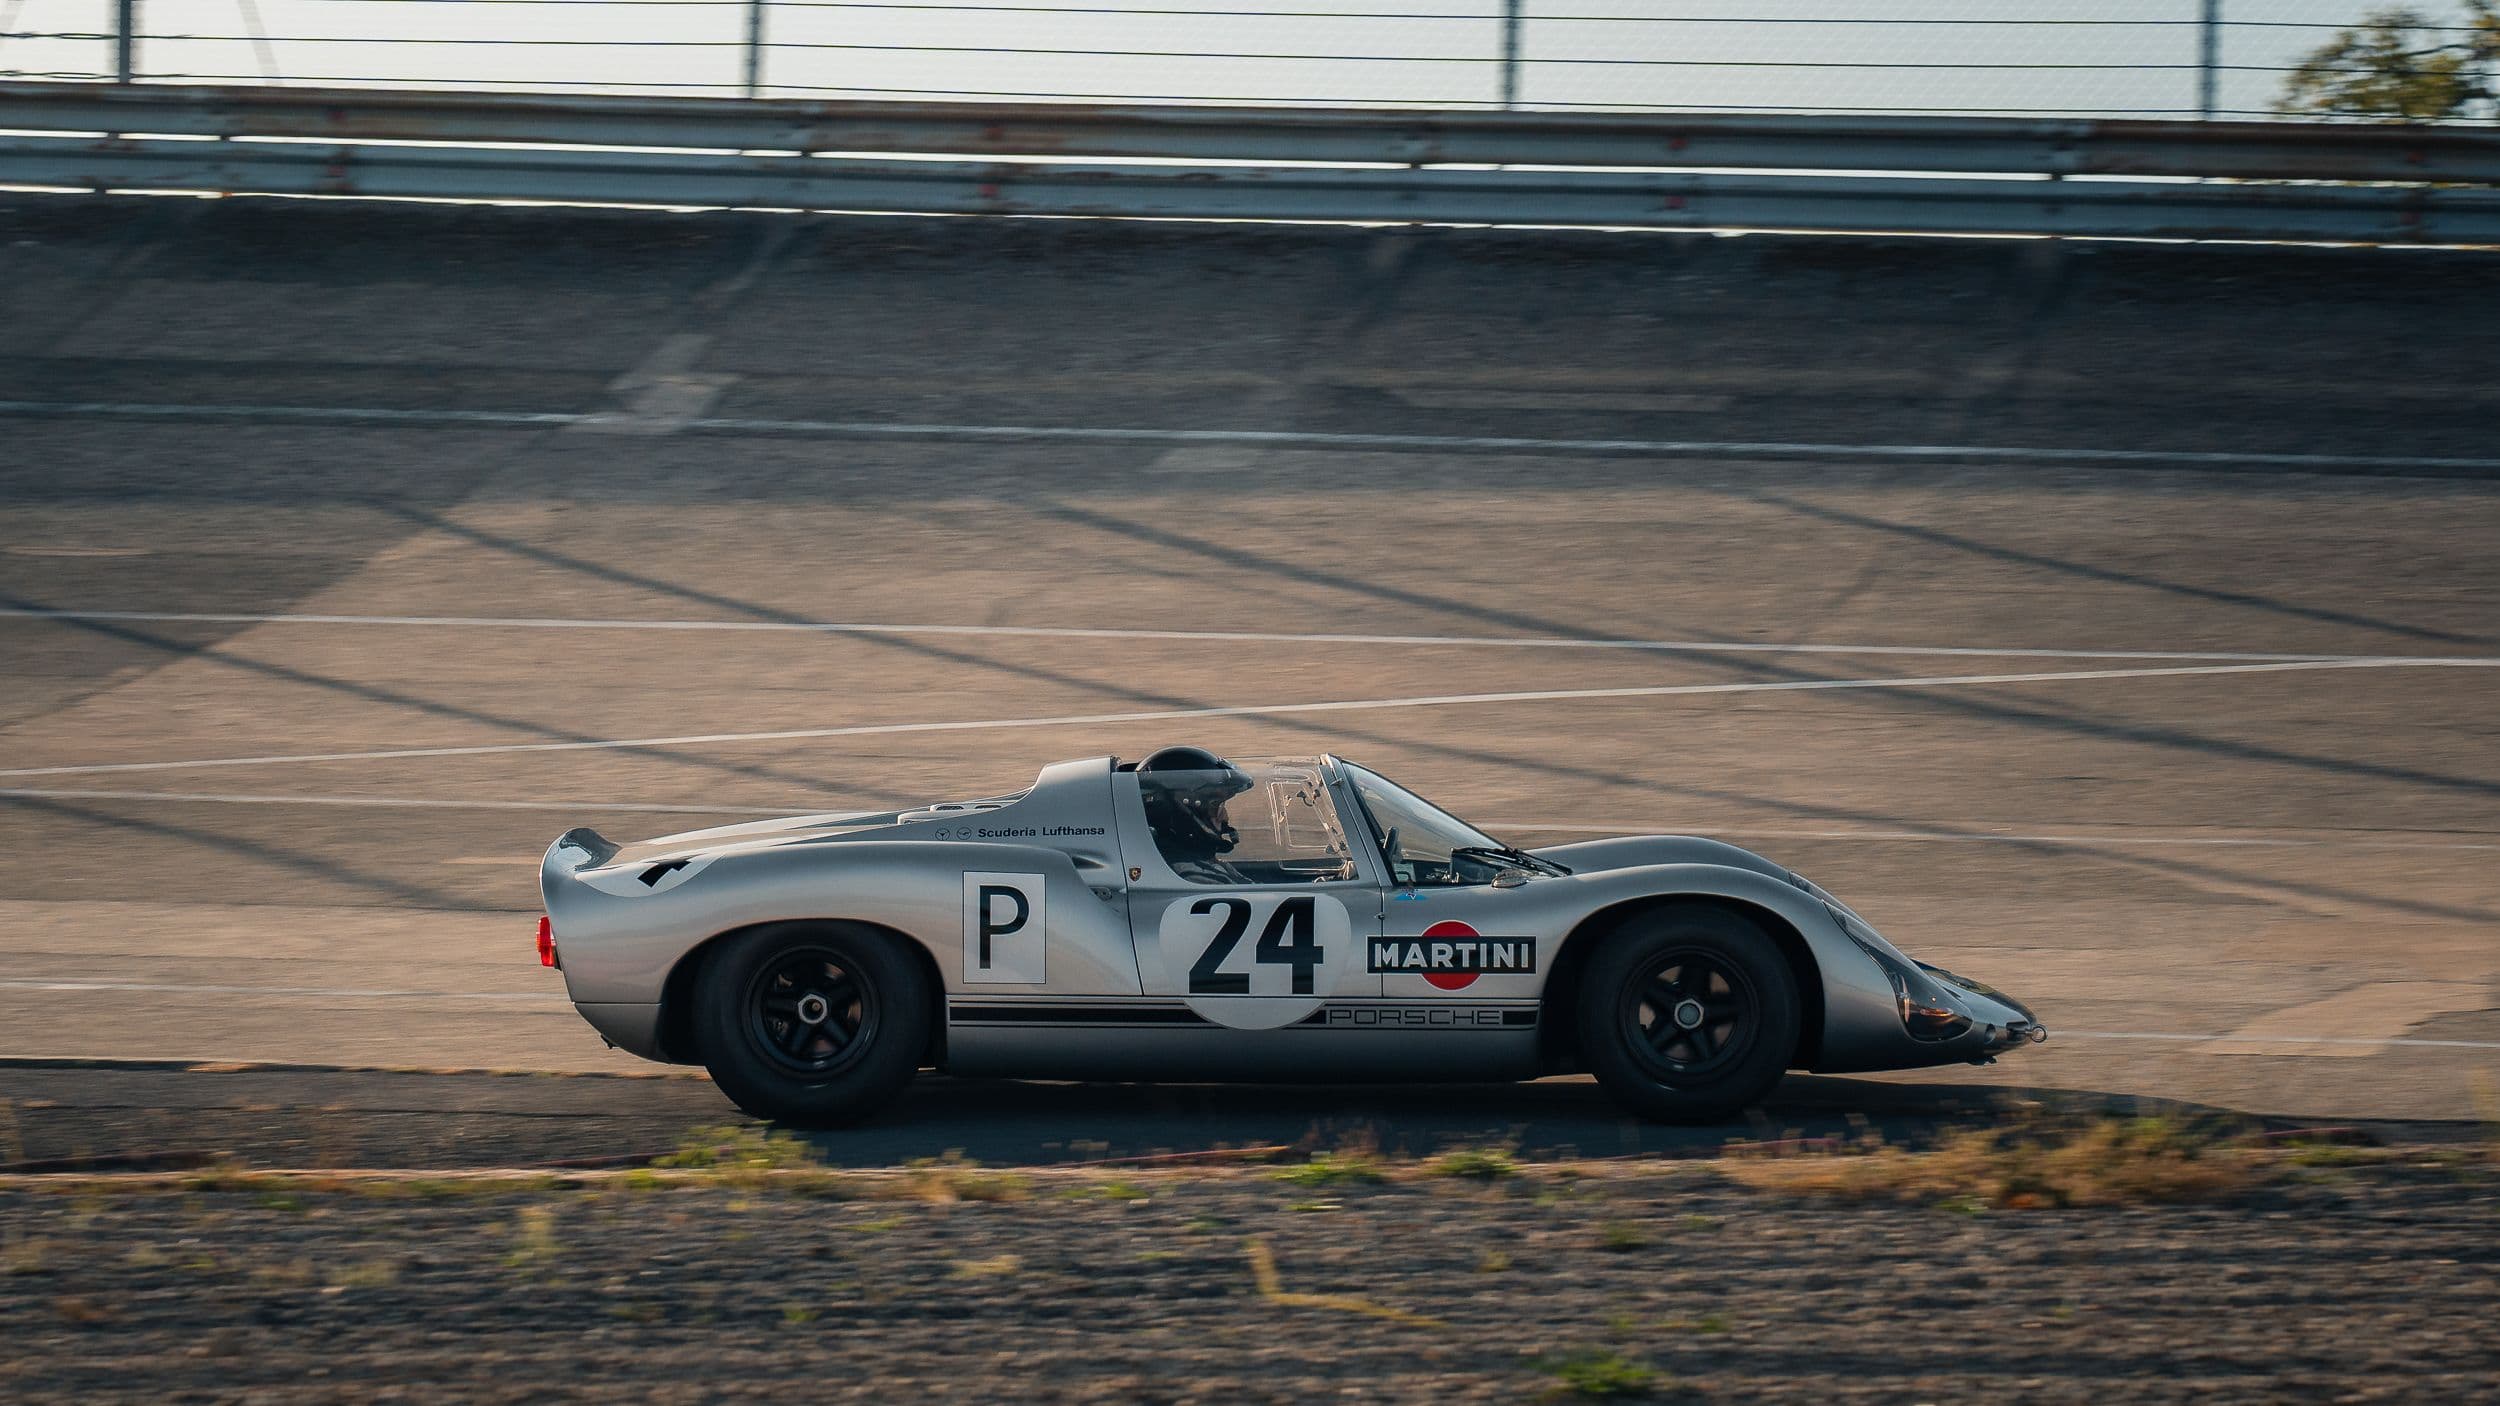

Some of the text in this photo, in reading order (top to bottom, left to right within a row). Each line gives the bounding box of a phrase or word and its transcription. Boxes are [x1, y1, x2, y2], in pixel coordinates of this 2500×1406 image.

[978, 826, 1105, 838] Scuderia Lufthansa
[979, 885, 1030, 969] P
[1188, 896, 1324, 994] 24
[1374, 943, 1529, 968] MARTINI
[1329, 1009, 1500, 1025] PORSCHE
